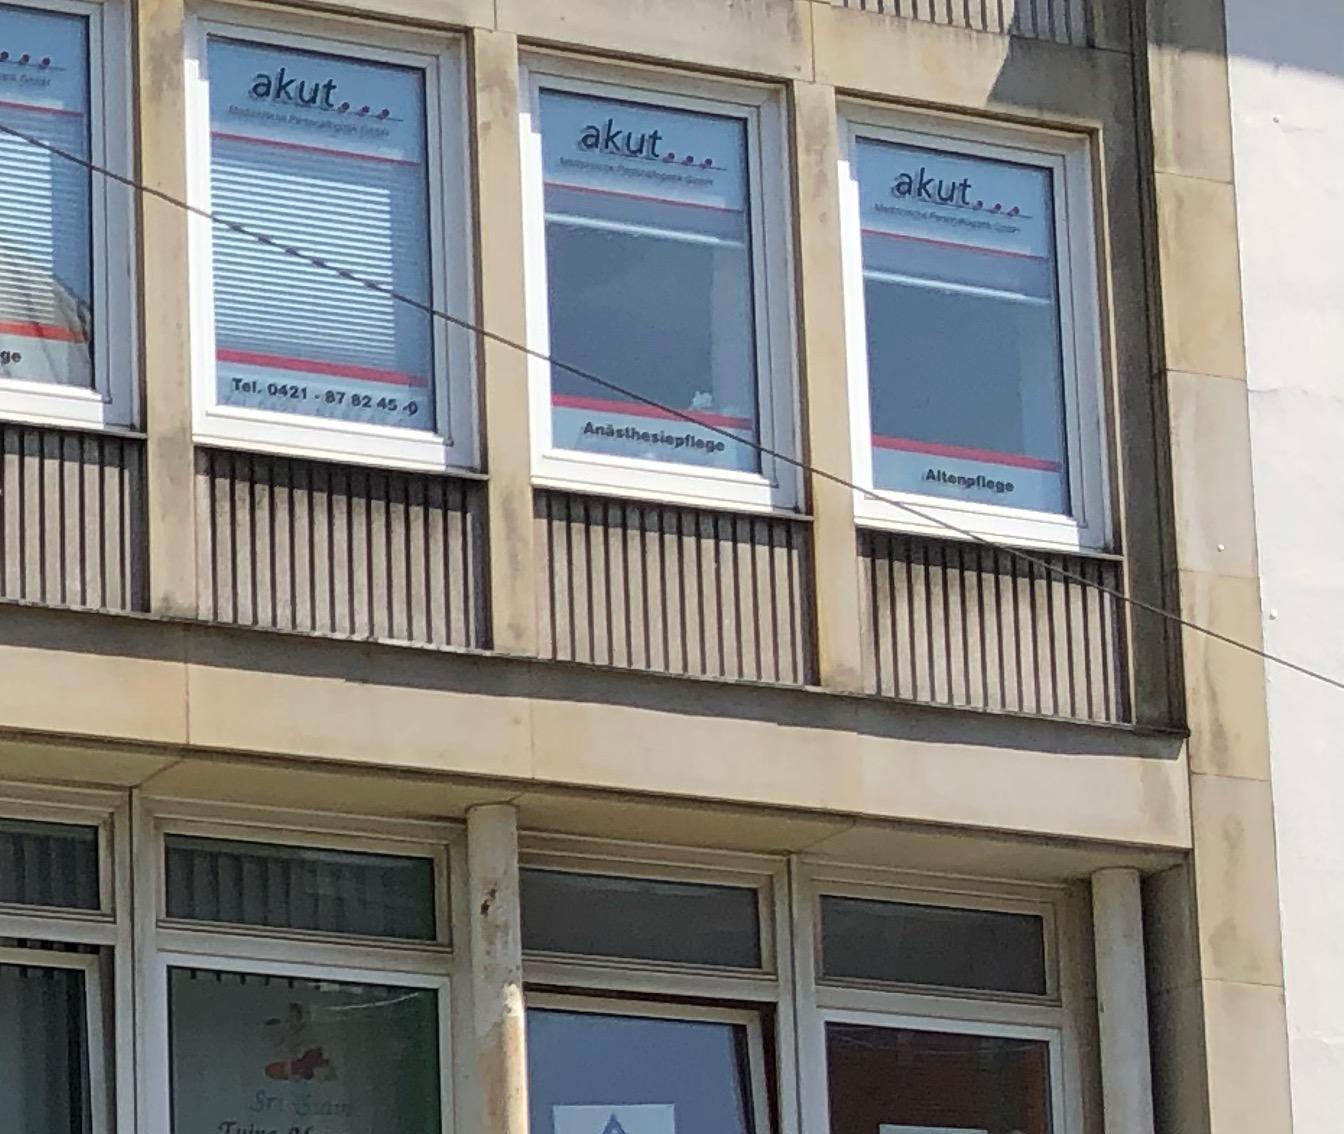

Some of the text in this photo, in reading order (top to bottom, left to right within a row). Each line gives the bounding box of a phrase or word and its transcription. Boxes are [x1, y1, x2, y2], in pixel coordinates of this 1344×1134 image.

[232, 378, 261, 395] Tel.
[267, 382, 308, 400] 0421
[325, 390, 346, 405] 87
[377, 396, 398, 411] 45
[584, 421, 726, 453] Anästhesiepflege
[926, 469, 1015, 493] Altenpflege
